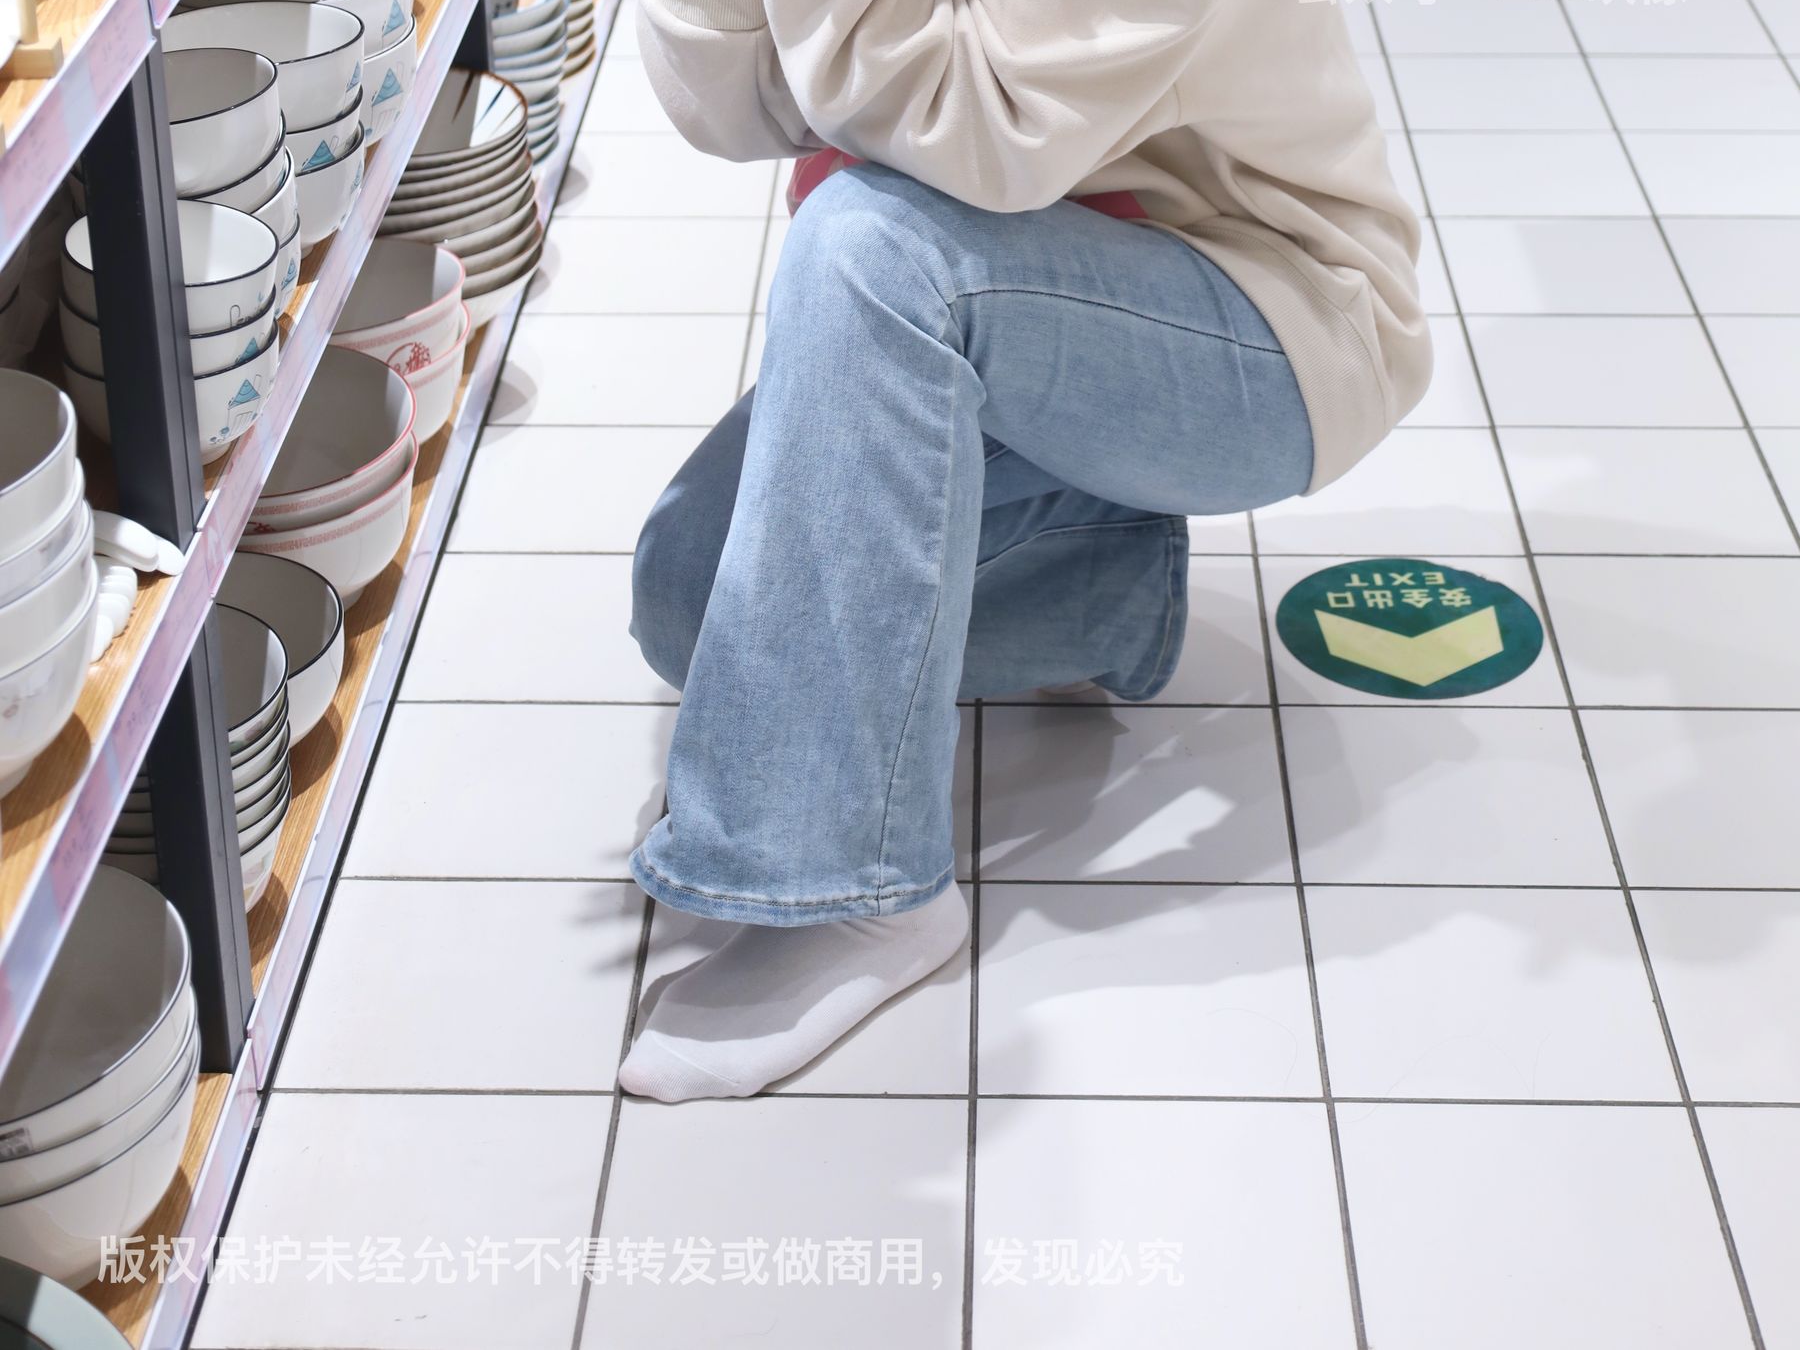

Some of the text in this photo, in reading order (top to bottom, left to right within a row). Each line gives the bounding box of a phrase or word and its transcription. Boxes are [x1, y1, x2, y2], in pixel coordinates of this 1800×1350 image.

[1345, 572, 1445, 587] EXIT
[1327, 588, 1472, 608] 安全出口
